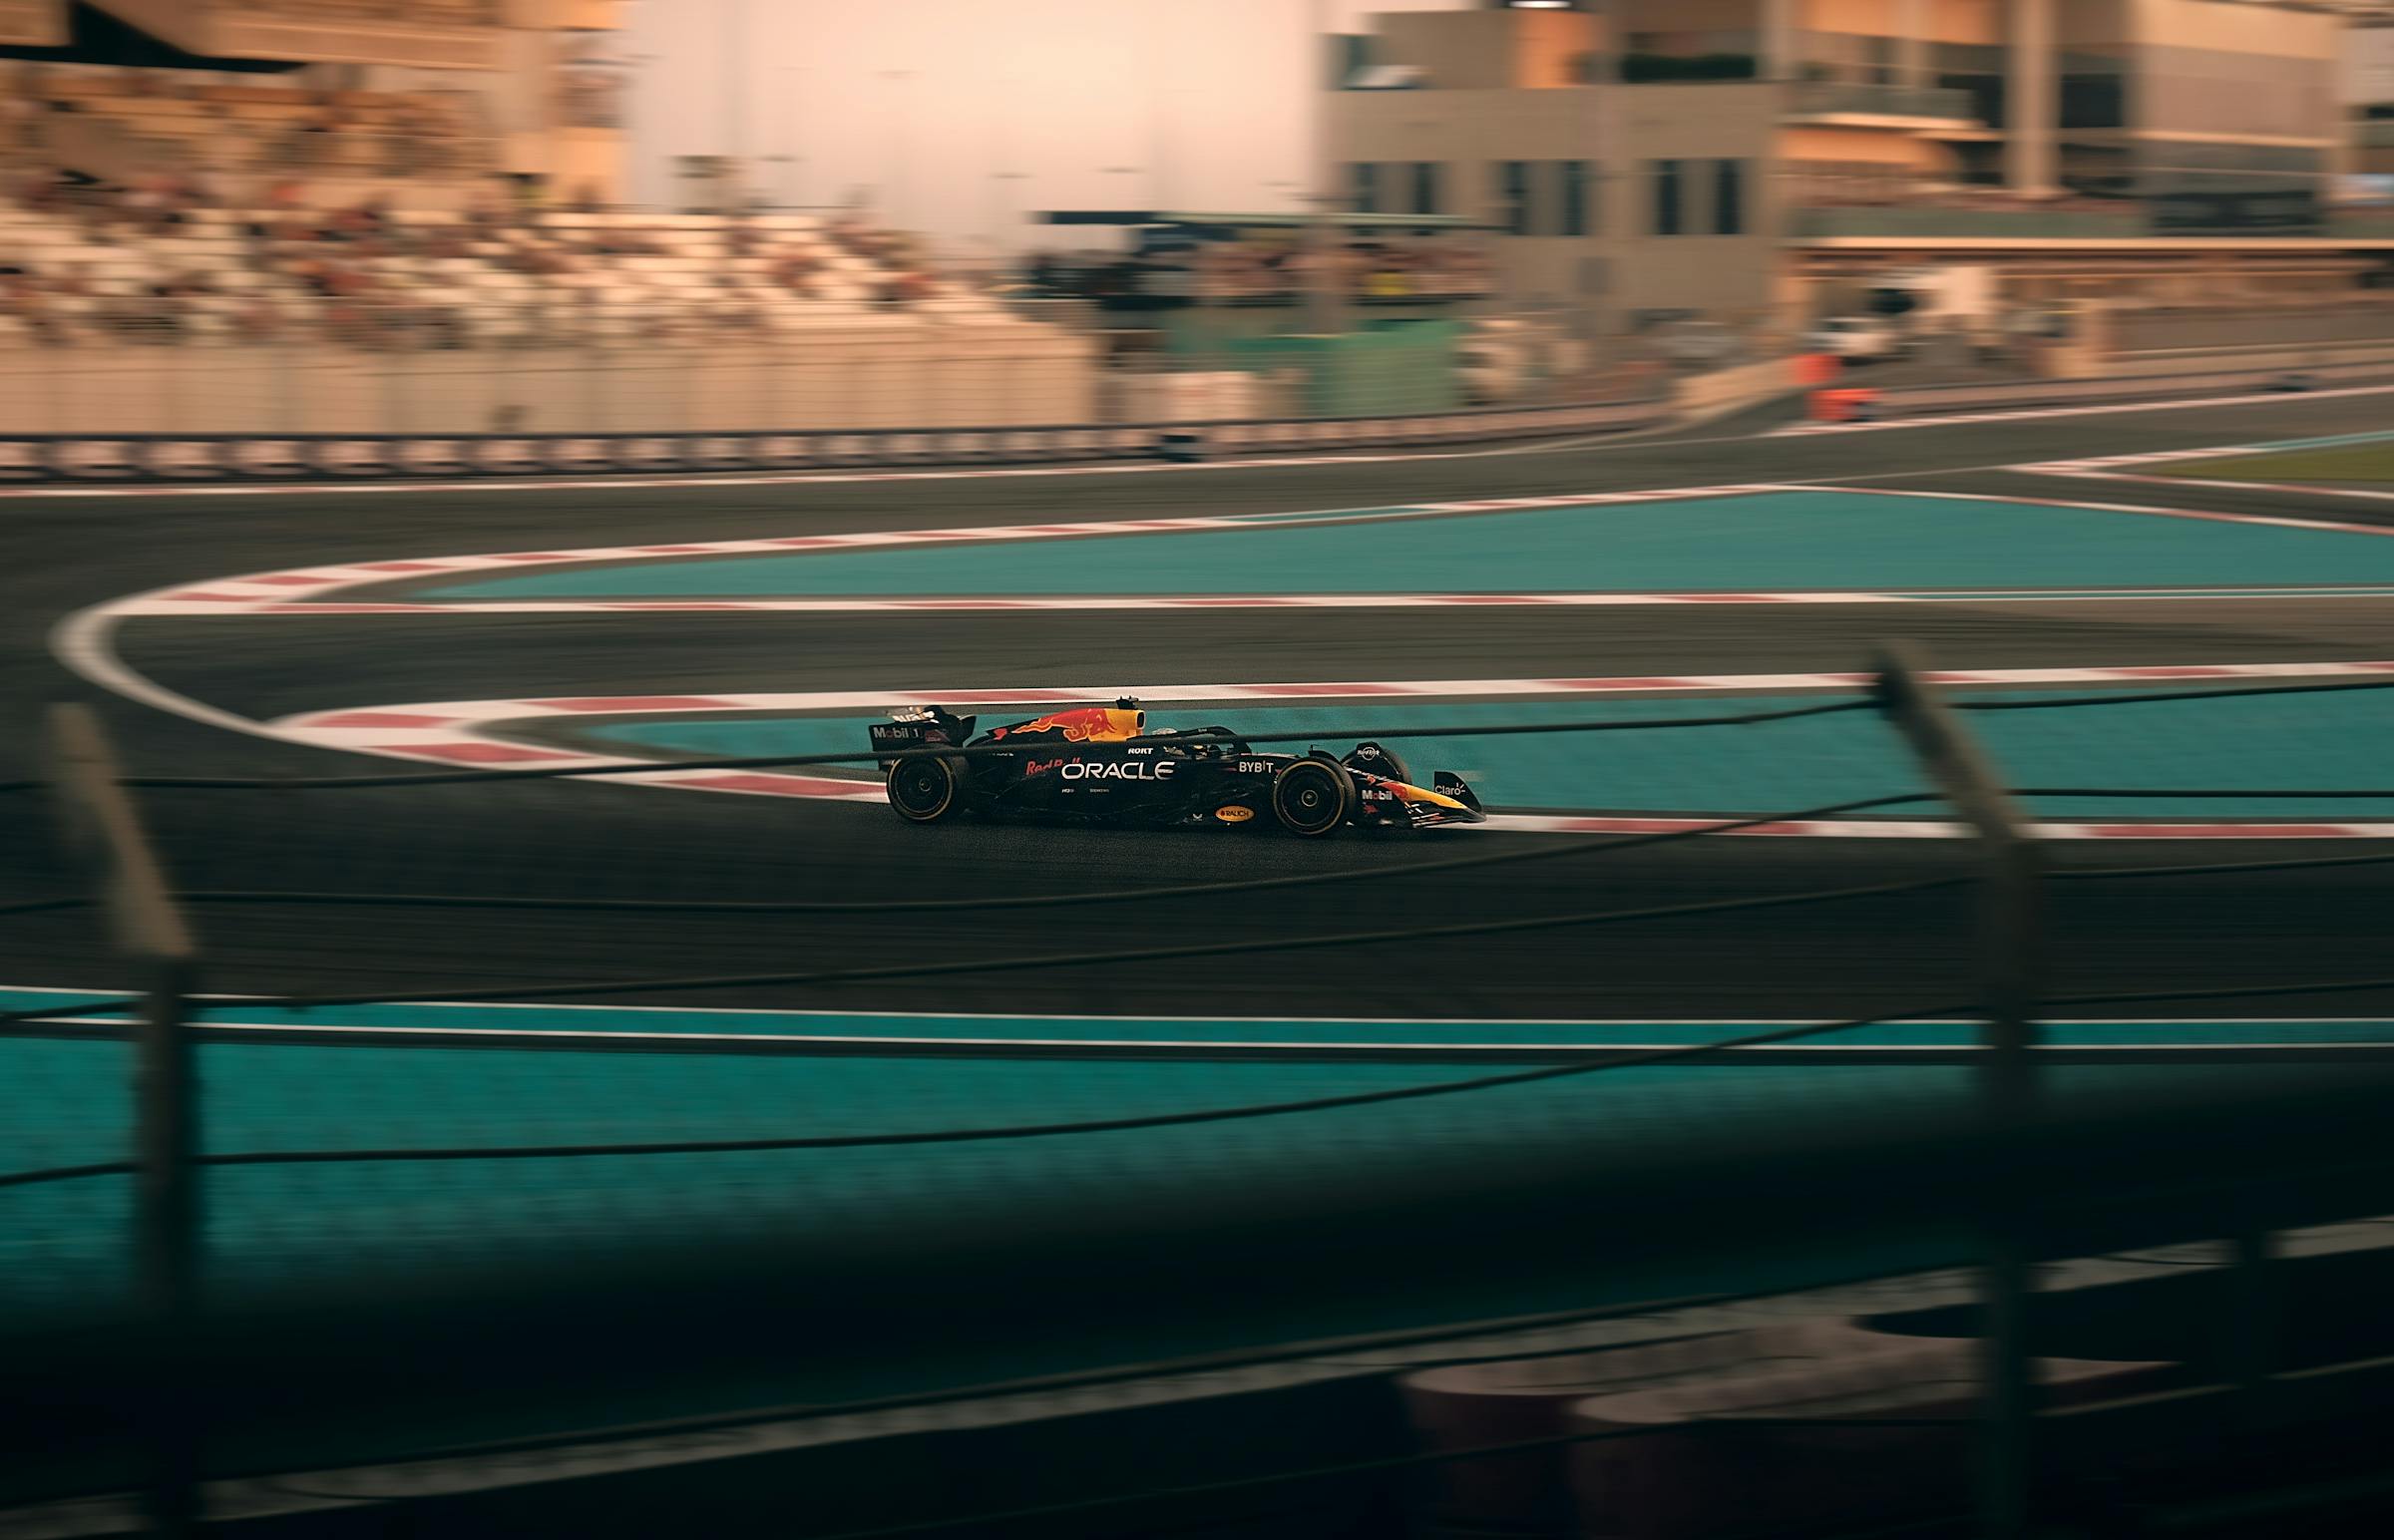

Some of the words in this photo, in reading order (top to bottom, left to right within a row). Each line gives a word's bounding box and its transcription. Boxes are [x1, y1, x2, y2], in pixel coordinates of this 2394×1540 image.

[873, 726, 909, 739] Mobil
[1025, 759, 1053, 776] Red
[1061, 761, 1175, 780] ORACLE
[1239, 760, 1274, 773] BYBIT
[1362, 790, 1393, 800] Mobil
